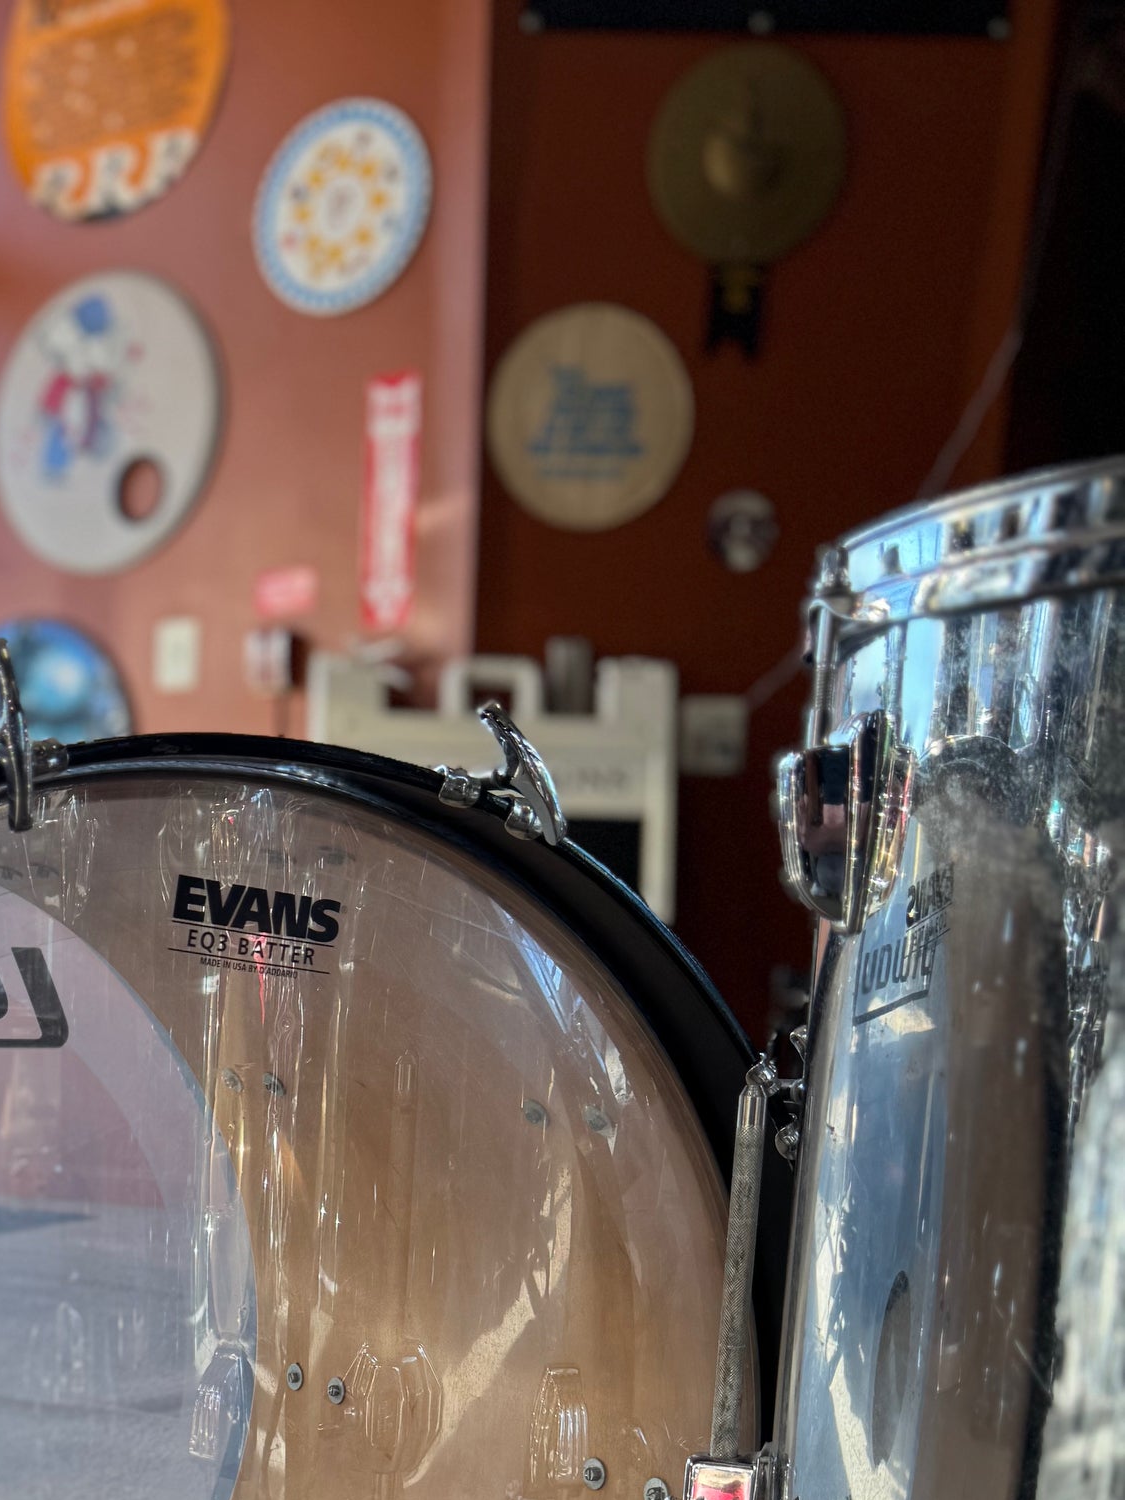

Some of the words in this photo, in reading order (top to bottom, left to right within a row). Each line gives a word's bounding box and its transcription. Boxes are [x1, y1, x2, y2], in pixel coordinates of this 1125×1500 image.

[173, 874, 341, 943] EVANS
[187, 929, 228, 953] EQ3
[238, 937, 315, 966] BATTER
[200, 956, 221, 968] MADE
[223, 960, 231, 969] IN
[232, 962, 247, 972] USA
